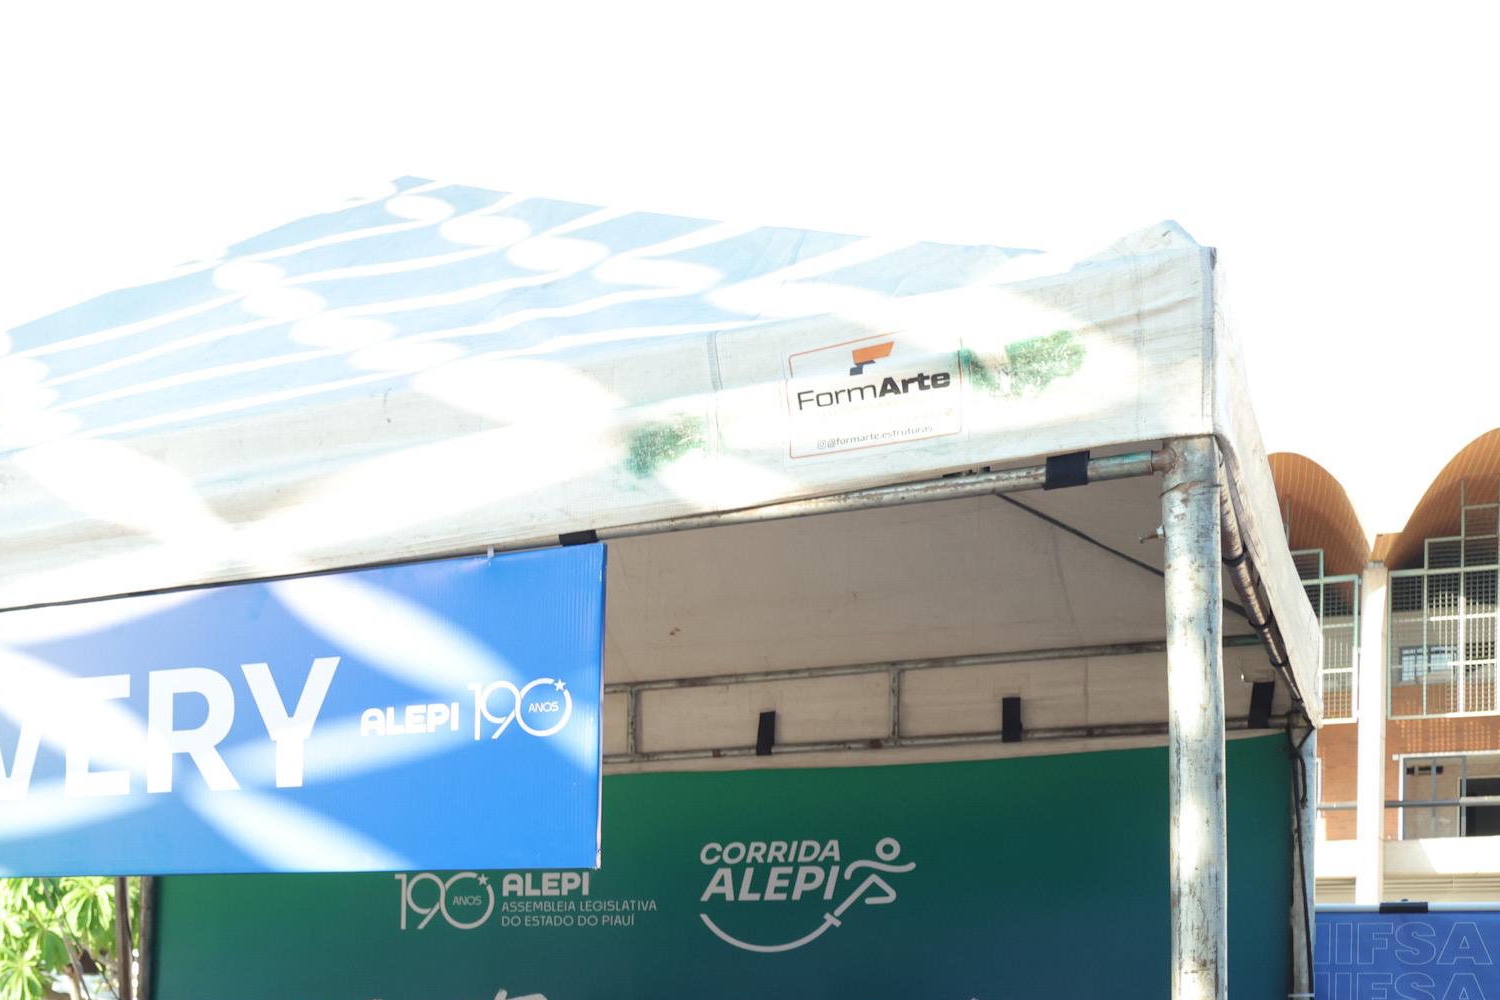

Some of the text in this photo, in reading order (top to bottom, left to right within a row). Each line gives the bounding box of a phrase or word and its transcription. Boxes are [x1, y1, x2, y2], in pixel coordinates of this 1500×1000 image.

[797, 372, 951, 411] FormArte
[360, 702, 460, 737] ALEPI
[528, 701, 559, 713] ANOS
[700, 839, 841, 865] CORRIDA
[502, 871, 590, 897] ALEPI
[700, 865, 841, 902] ALEPI
[452, 895, 482, 906] ANOS
[501, 899, 657, 913] ASSEMBLEIA LEGISLATIVA
[501, 913, 635, 927] DO ESTADO DO PIAUÍ
